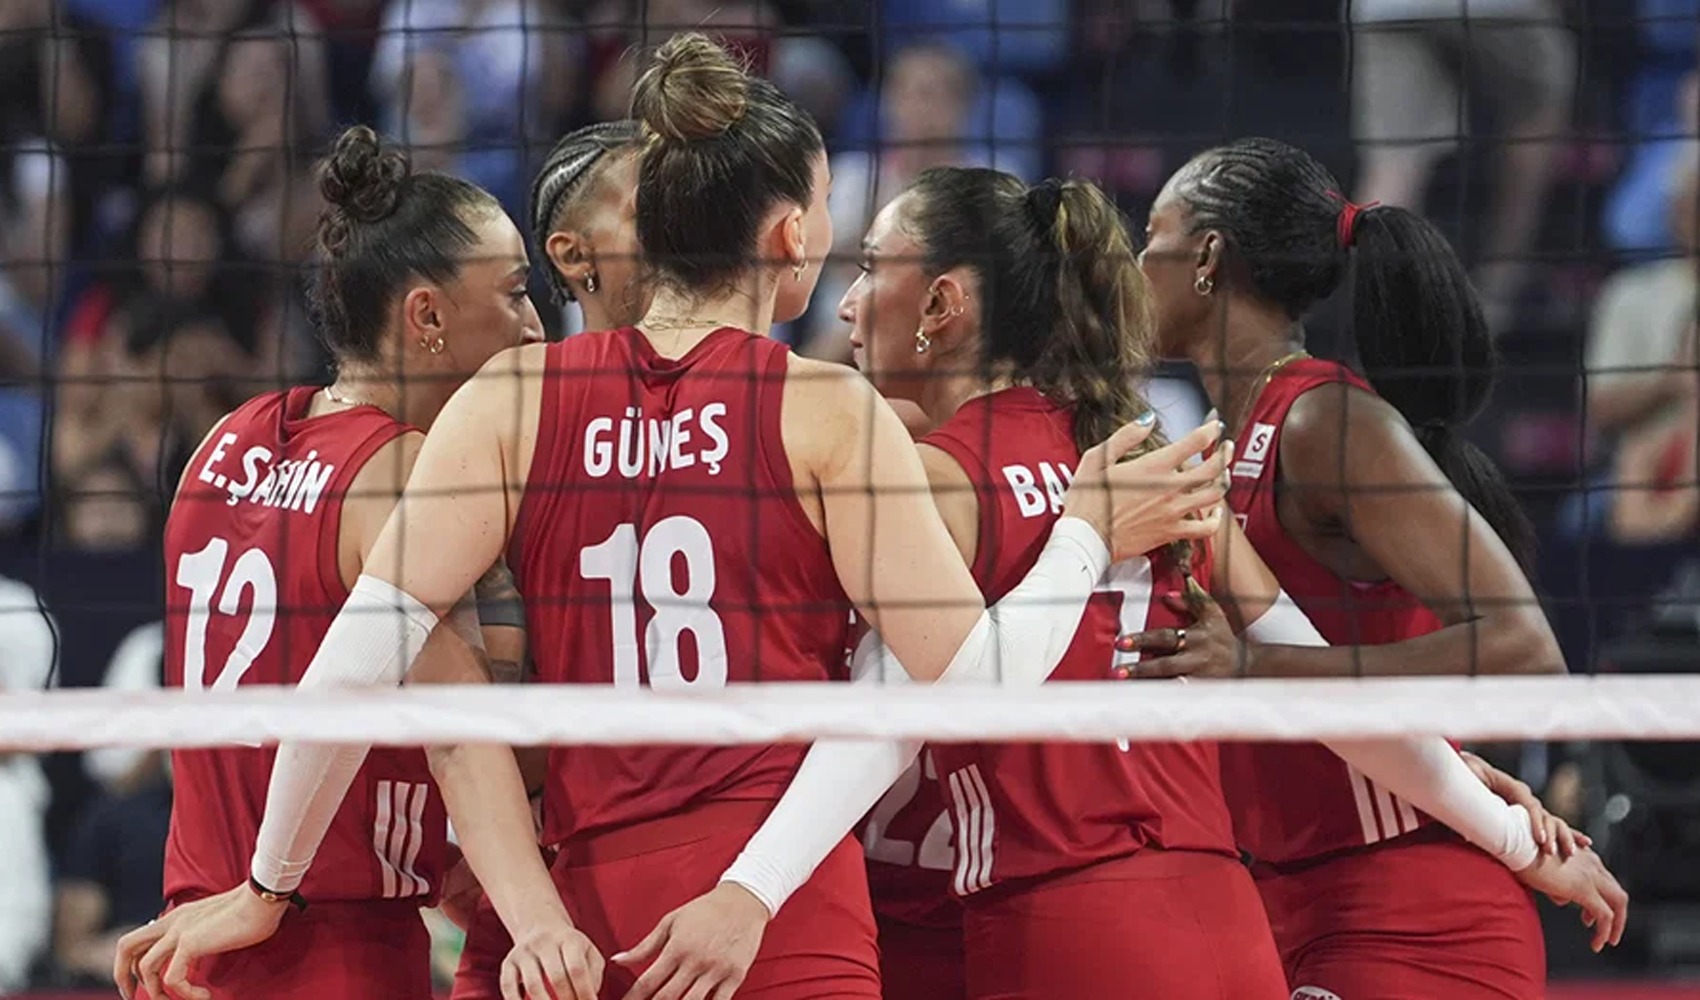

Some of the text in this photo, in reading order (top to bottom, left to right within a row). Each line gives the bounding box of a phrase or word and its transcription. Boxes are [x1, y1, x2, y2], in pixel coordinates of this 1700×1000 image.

[584, 402, 729, 477] GÜNEŞ
[1252, 432, 1268, 453] S
[177, 537, 277, 747] 12
[580, 515, 728, 690] 18
